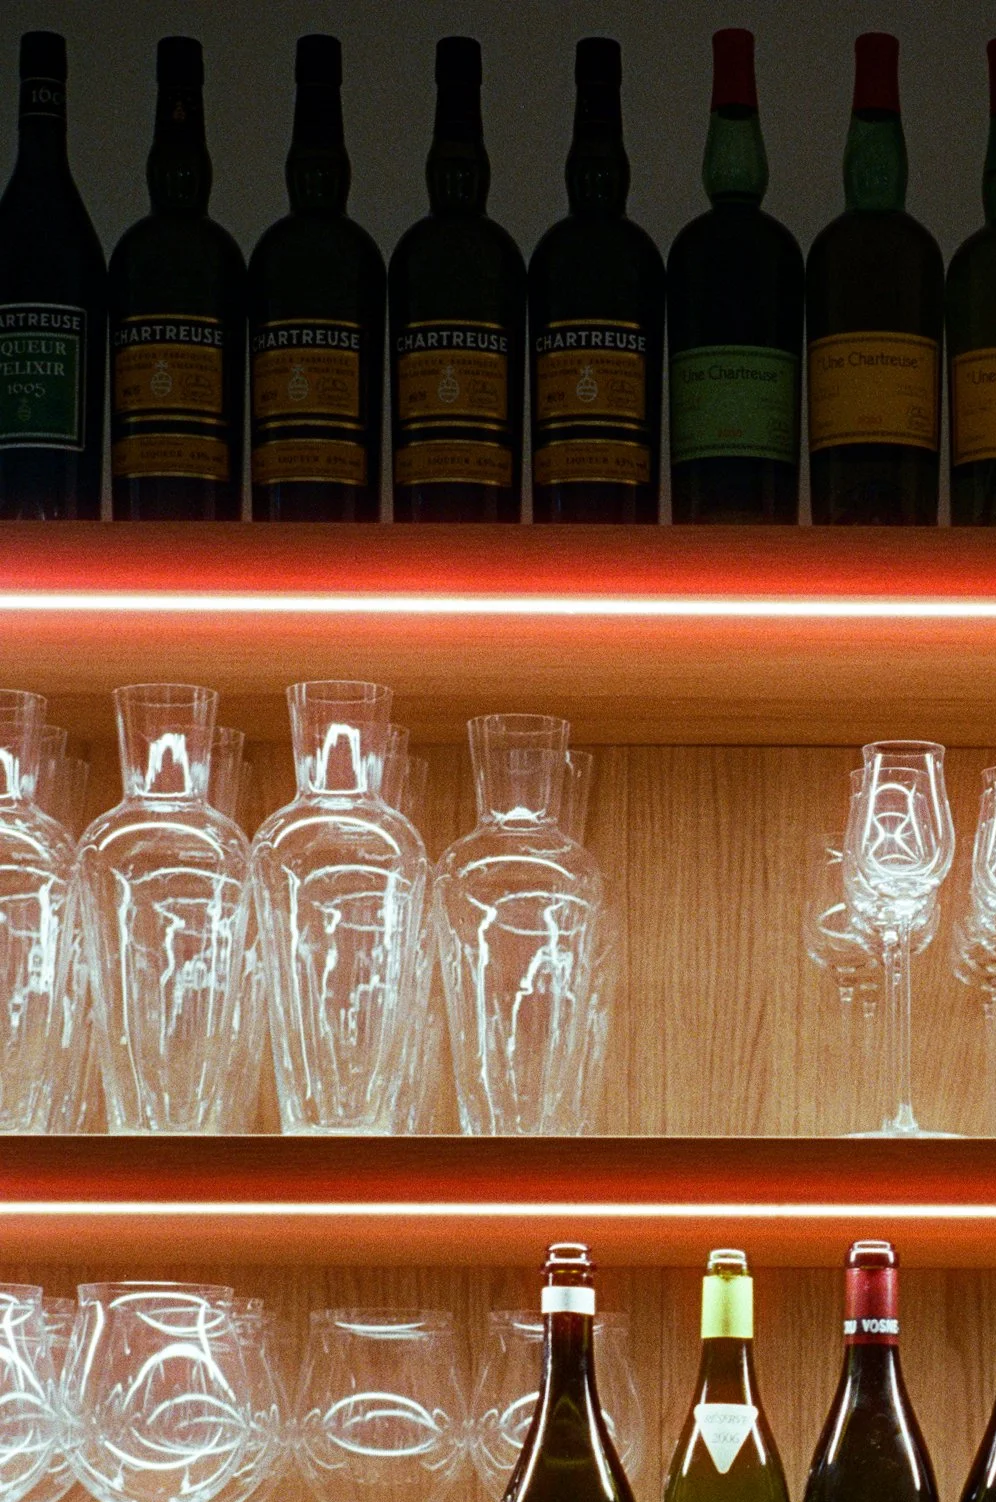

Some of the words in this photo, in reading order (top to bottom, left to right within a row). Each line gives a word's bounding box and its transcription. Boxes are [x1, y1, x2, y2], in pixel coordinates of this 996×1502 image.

[114, 325, 224, 347] CHARTREUSE
[253, 330, 361, 352] CHARTREUSE
[397, 330, 508, 353] CHARTREUSE
[535, 330, 647, 353] CHARTREUSE
